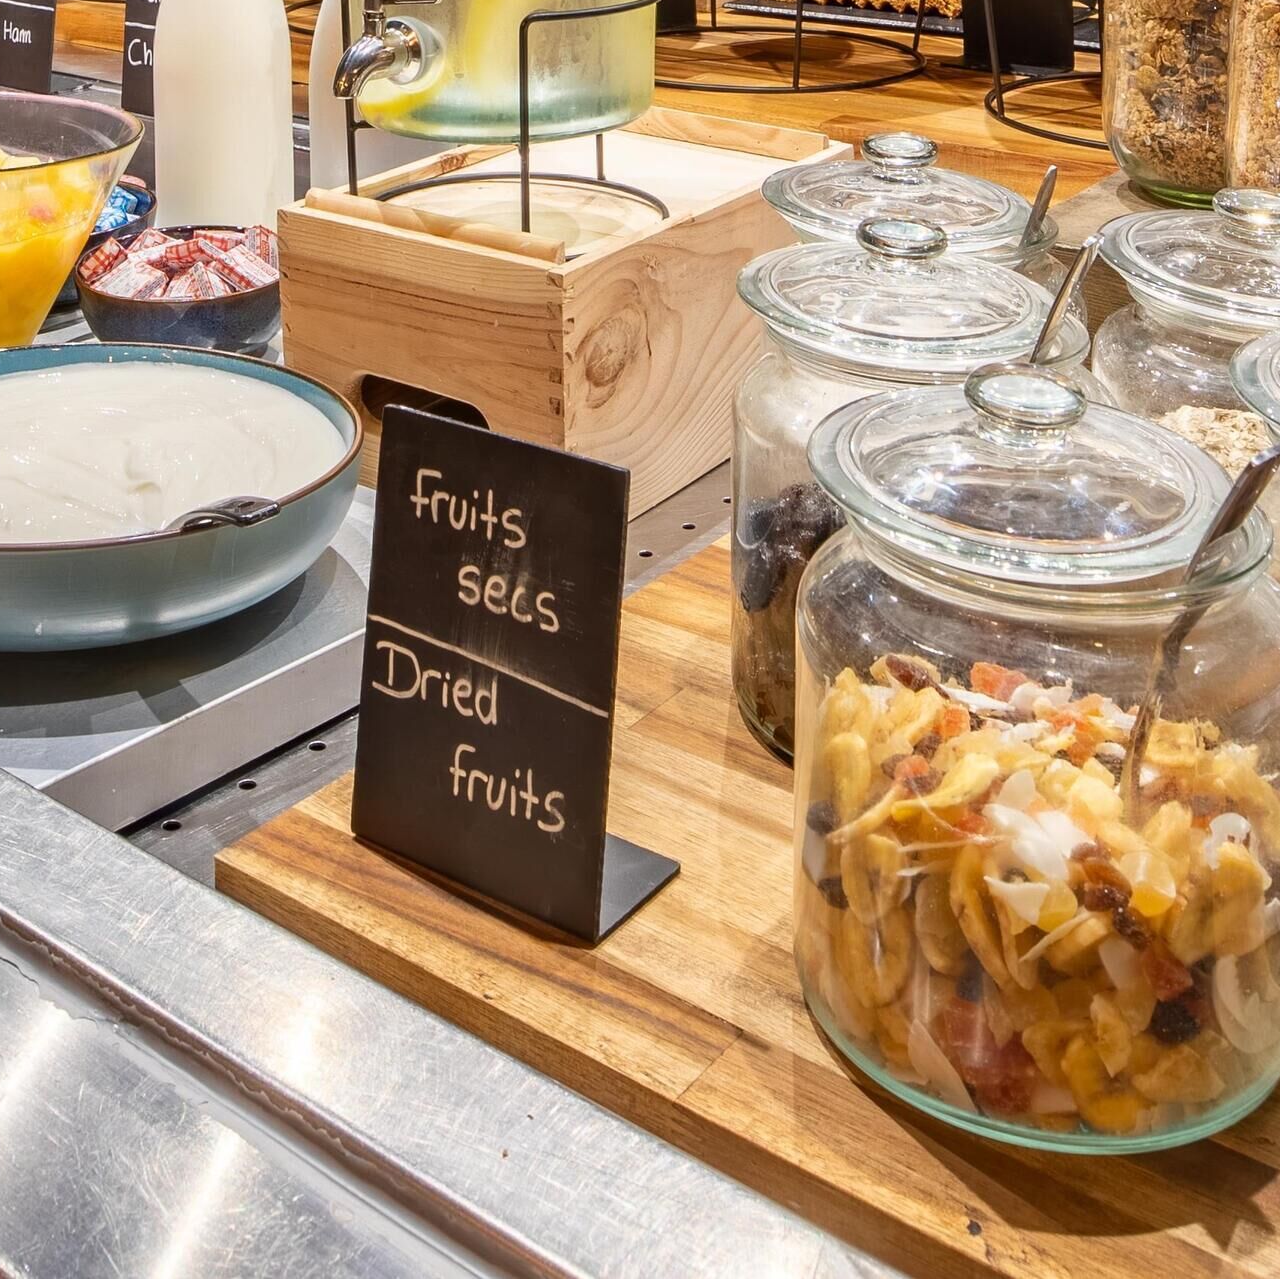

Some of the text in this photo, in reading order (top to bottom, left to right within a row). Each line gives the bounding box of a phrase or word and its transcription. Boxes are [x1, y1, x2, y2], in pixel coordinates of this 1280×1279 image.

[3, 20, 32, 43] Ham
[410, 468, 527, 549] Fruits
[458, 565, 560, 633] secs
[372, 640, 498, 726] Dried
[449, 743, 565, 833] fruits
